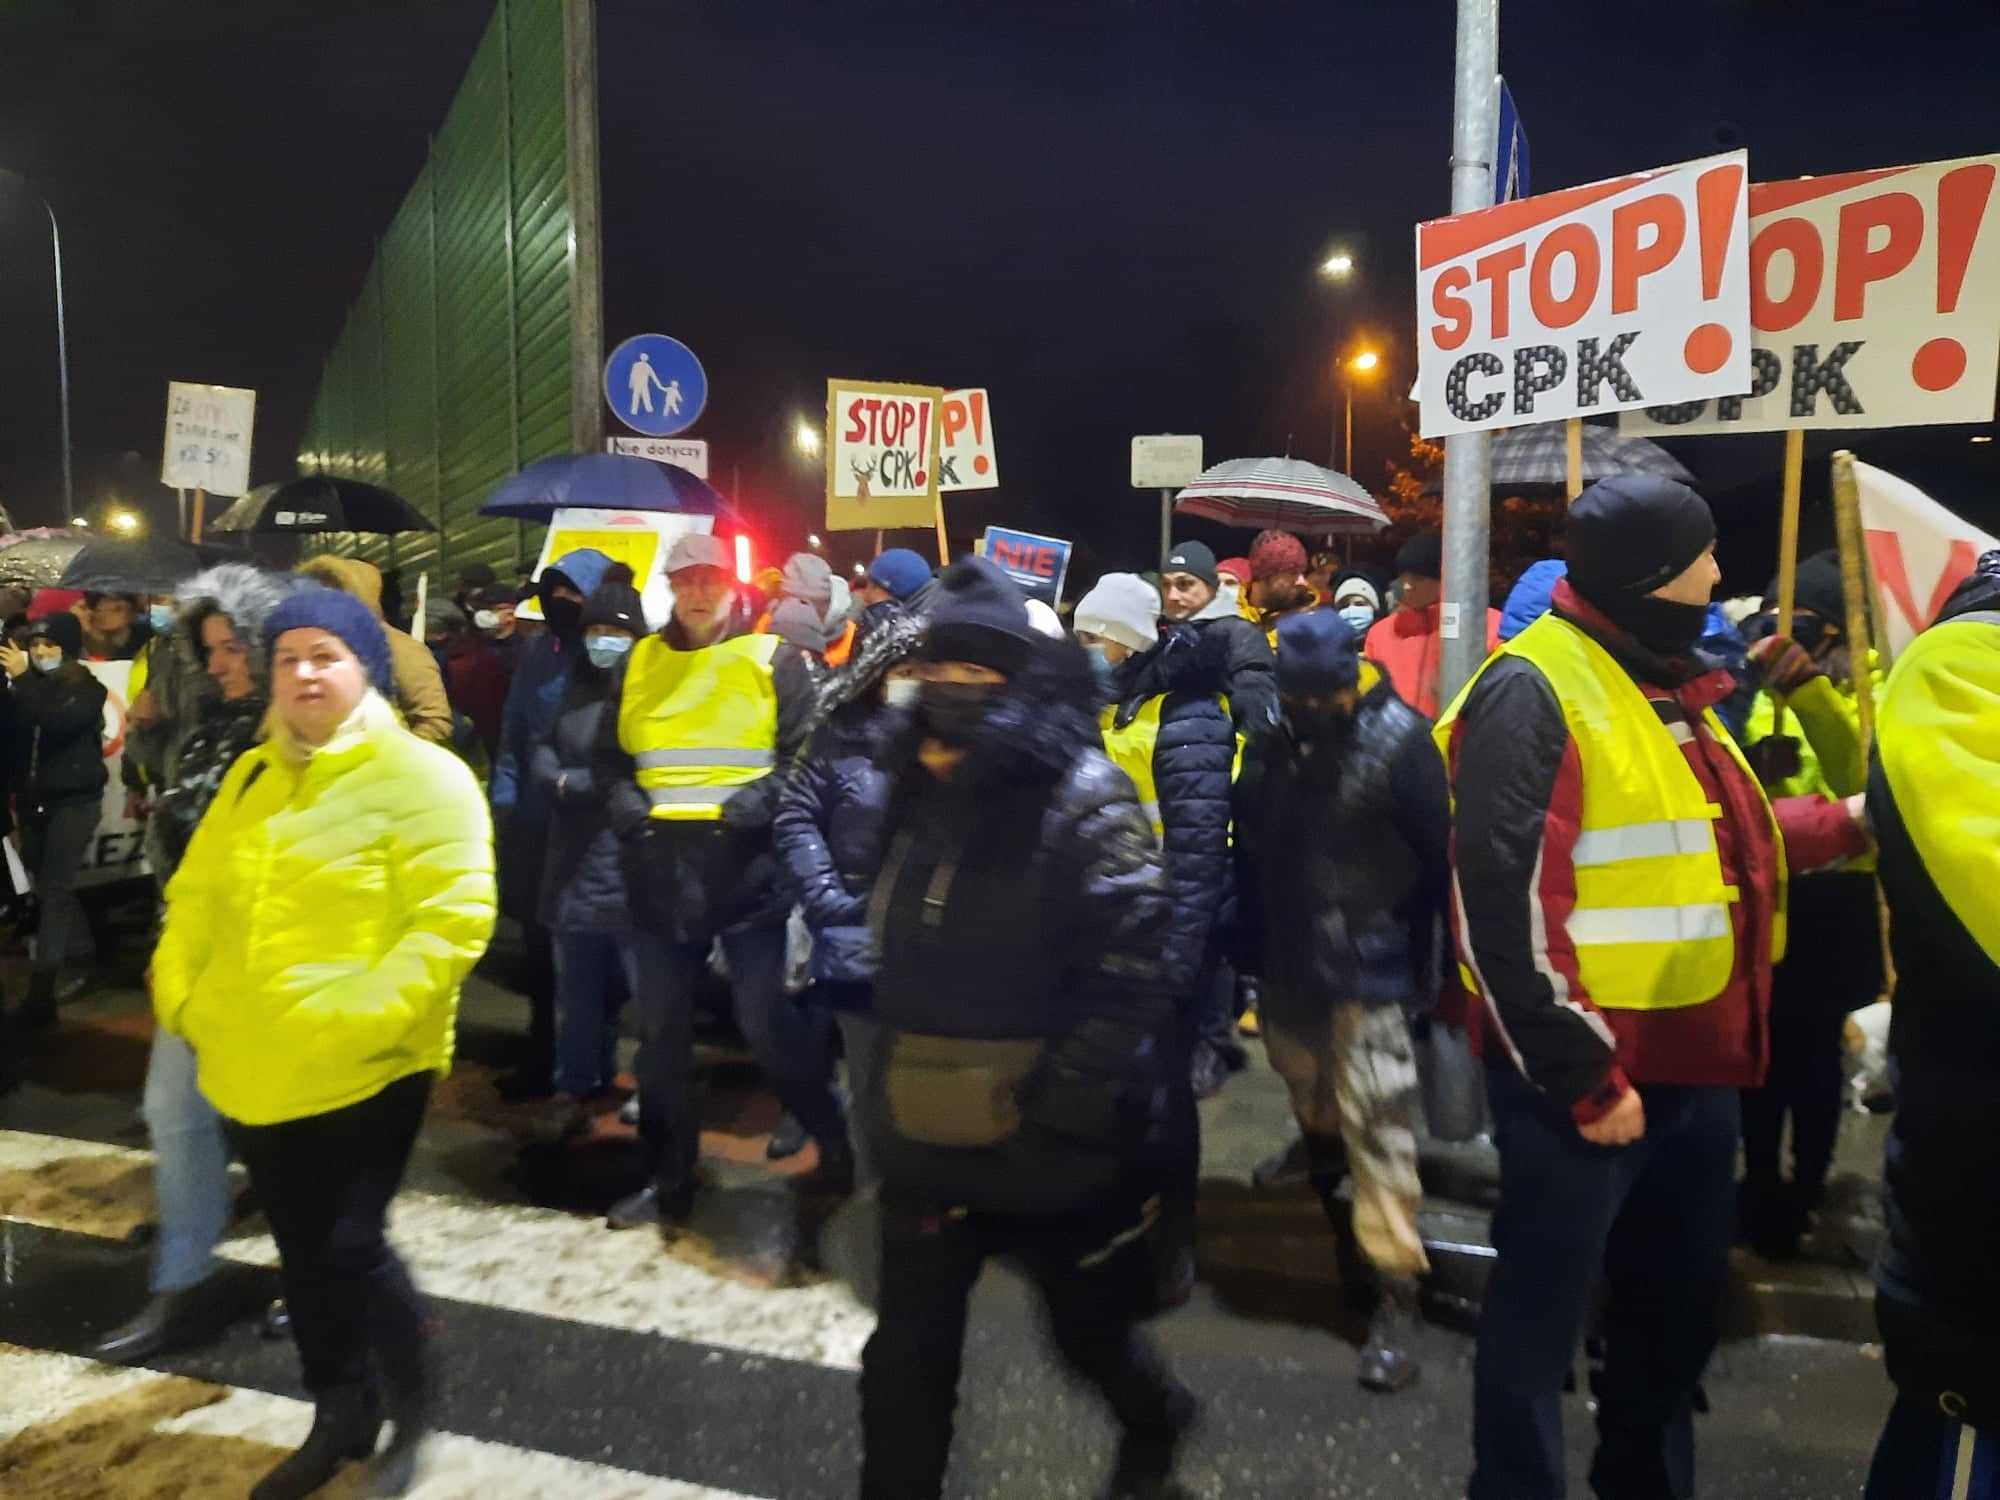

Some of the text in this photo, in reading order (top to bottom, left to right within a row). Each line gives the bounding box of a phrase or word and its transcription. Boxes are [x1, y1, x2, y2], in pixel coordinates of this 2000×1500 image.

[1432, 165, 1744, 374] STOP!
[1750, 164, 1996, 392] OP!
[1446, 331, 1644, 422] CPK
[647, 444, 700, 459] dotyczy
[845, 398, 930, 487] STOP!
[880, 450, 917, 490] CPK
[992, 537, 1057, 577] NIE
